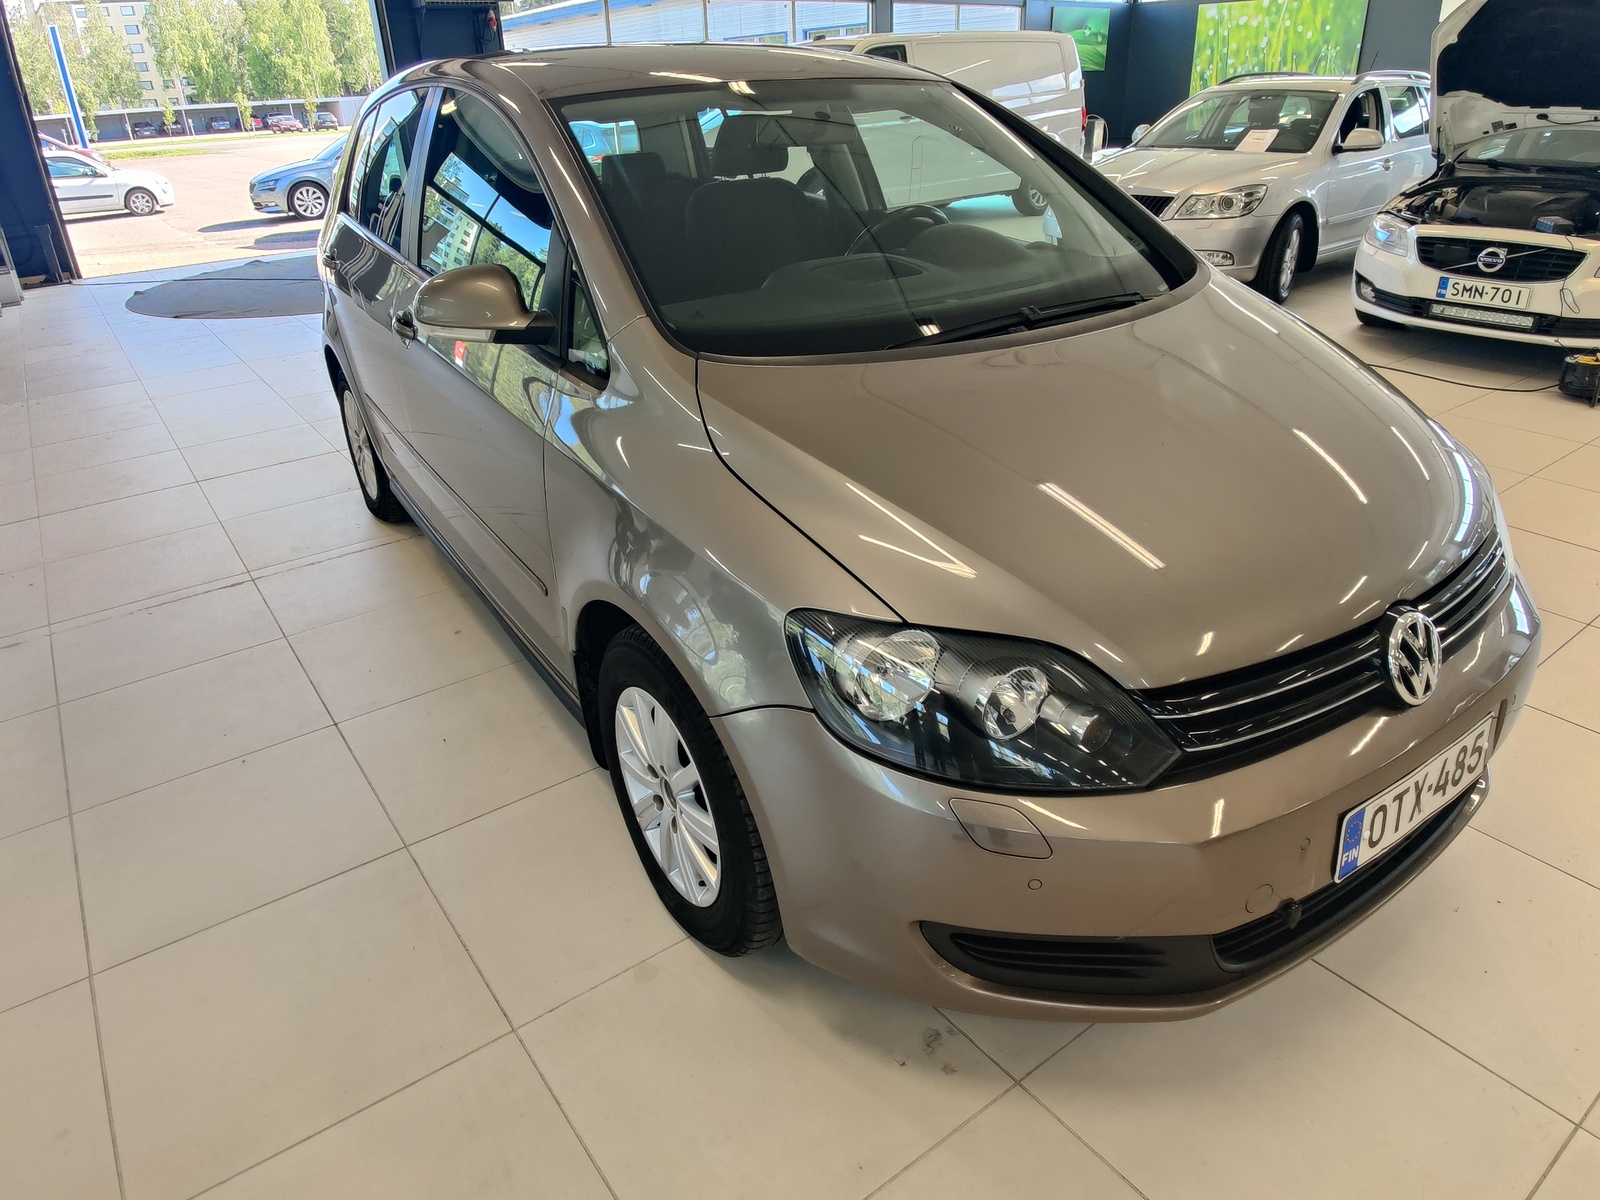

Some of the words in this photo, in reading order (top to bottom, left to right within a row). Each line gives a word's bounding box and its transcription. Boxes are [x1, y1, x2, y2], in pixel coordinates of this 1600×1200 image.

[1479, 256, 1503, 264] VOLVO
[1450, 281, 1521, 306] SMN-701
[1367, 731, 1486, 849] OTX-485
[1341, 844, 1360, 866] FIN
